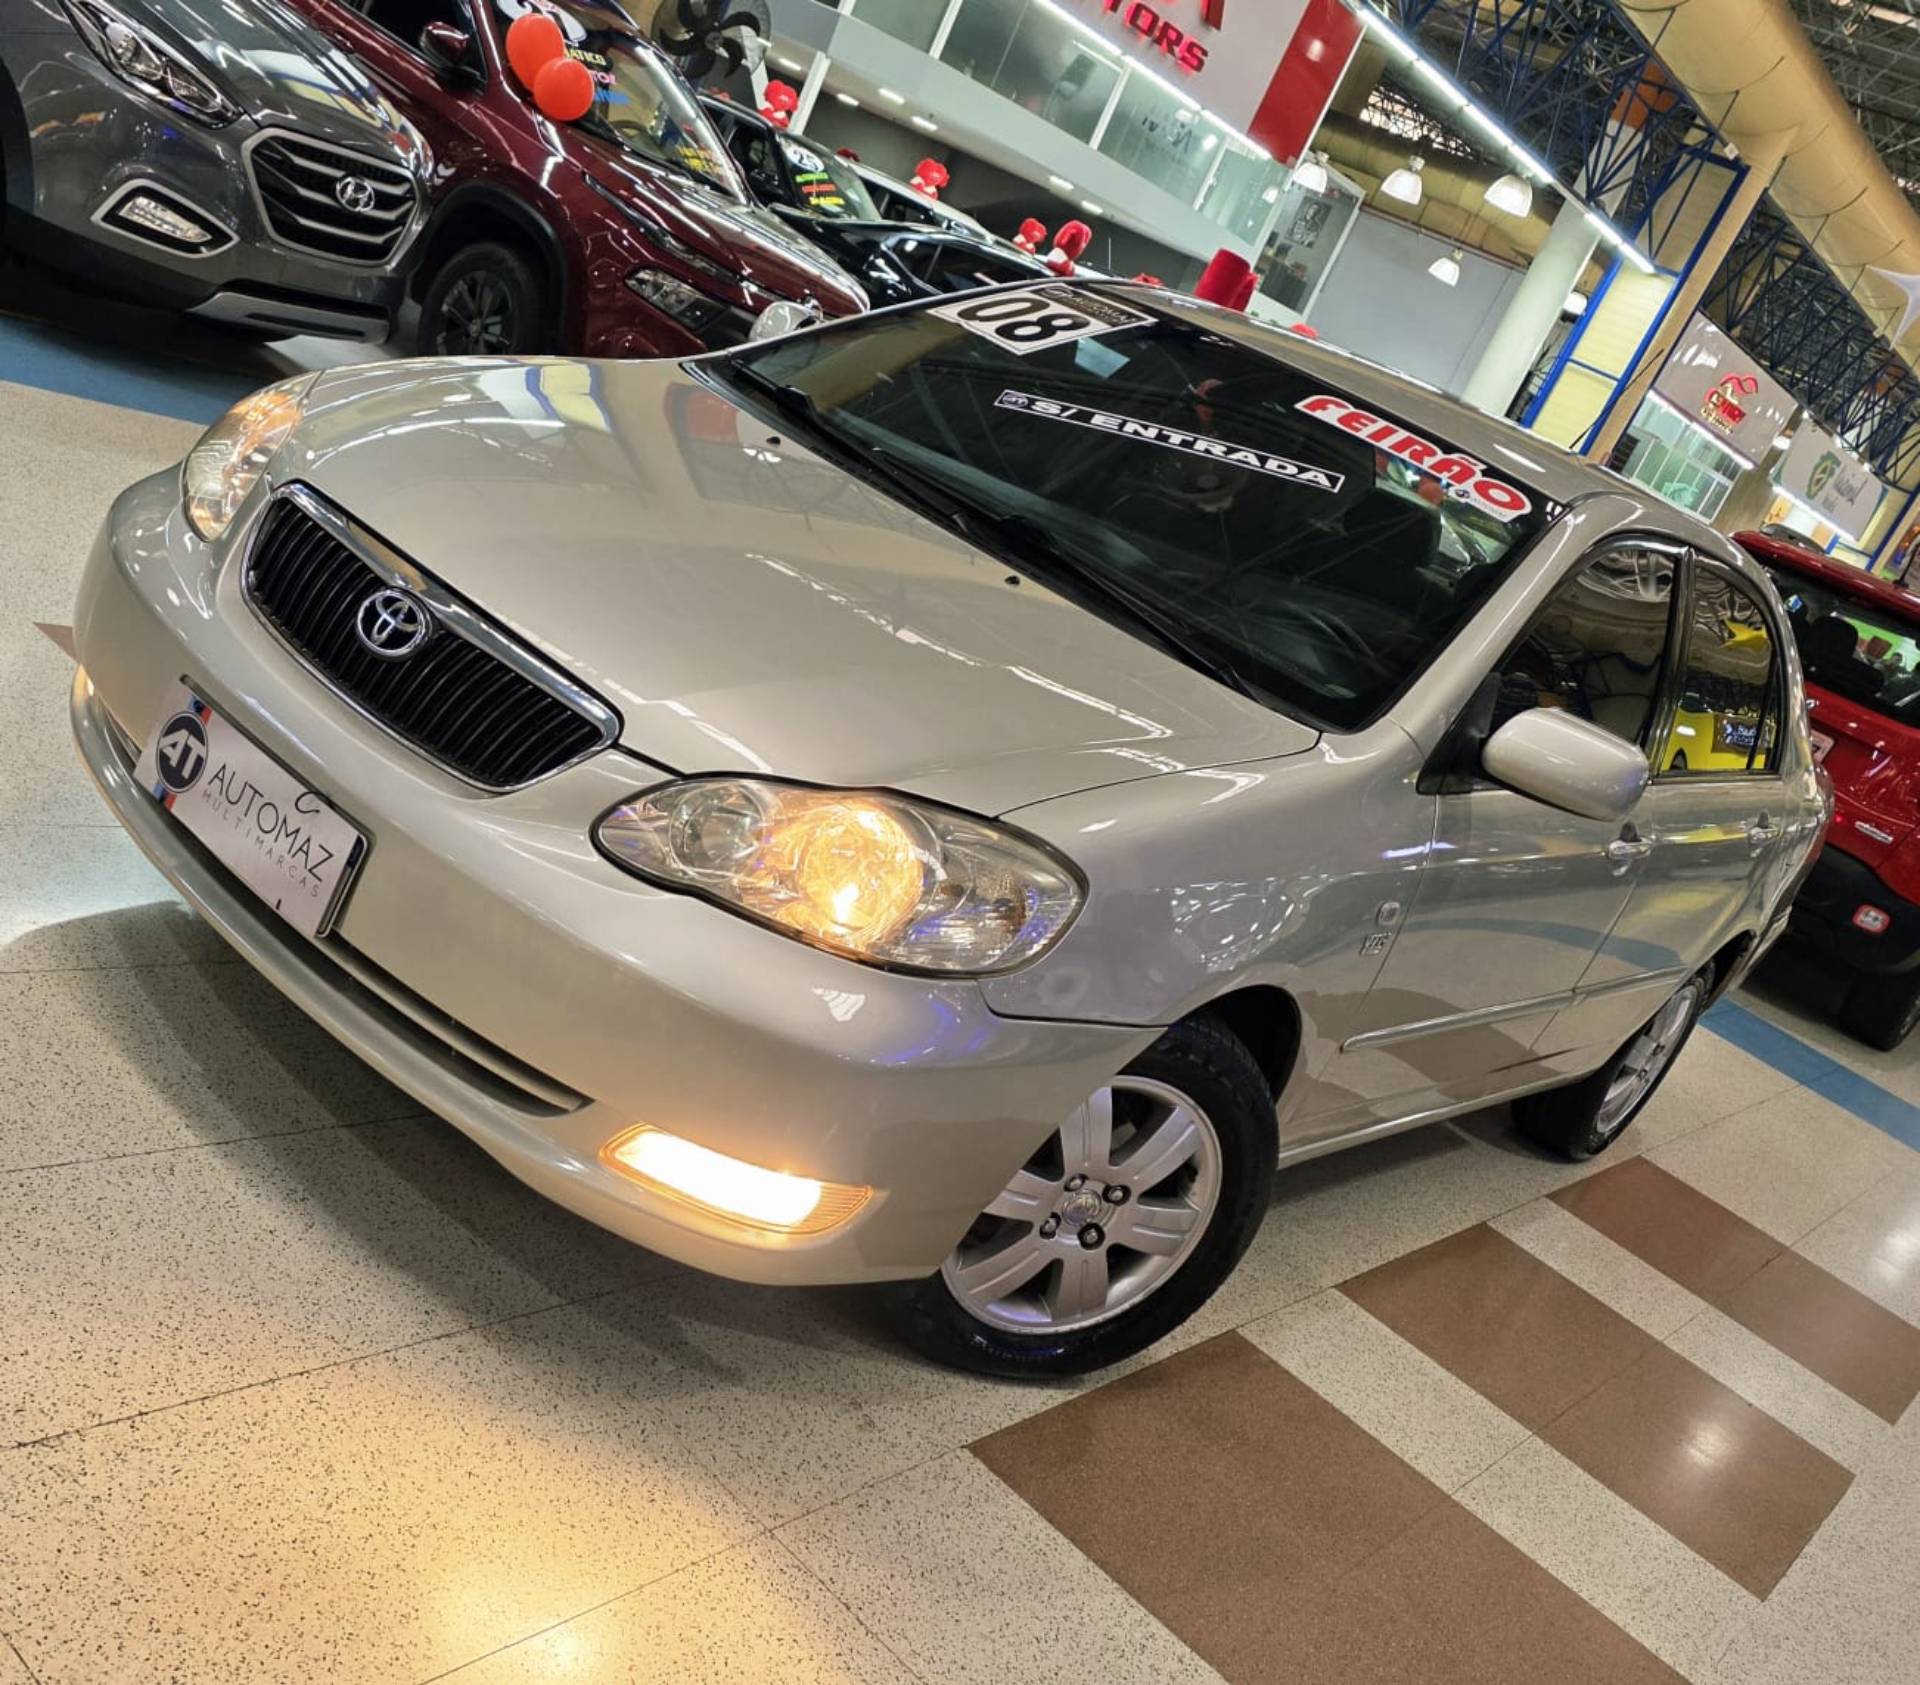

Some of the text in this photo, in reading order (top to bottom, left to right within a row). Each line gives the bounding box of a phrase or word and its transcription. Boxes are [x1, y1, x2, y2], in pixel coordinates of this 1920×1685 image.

[957, 296, 1091, 343] 08
[1031, 400, 1079, 418] S/
[1090, 413, 1333, 489] ENTRADA
[1302, 396, 1528, 512] FEIRÃO
[202, 790, 320, 898] MULTIMARCAS
[208, 764, 335, 883] AUTOMAZ
